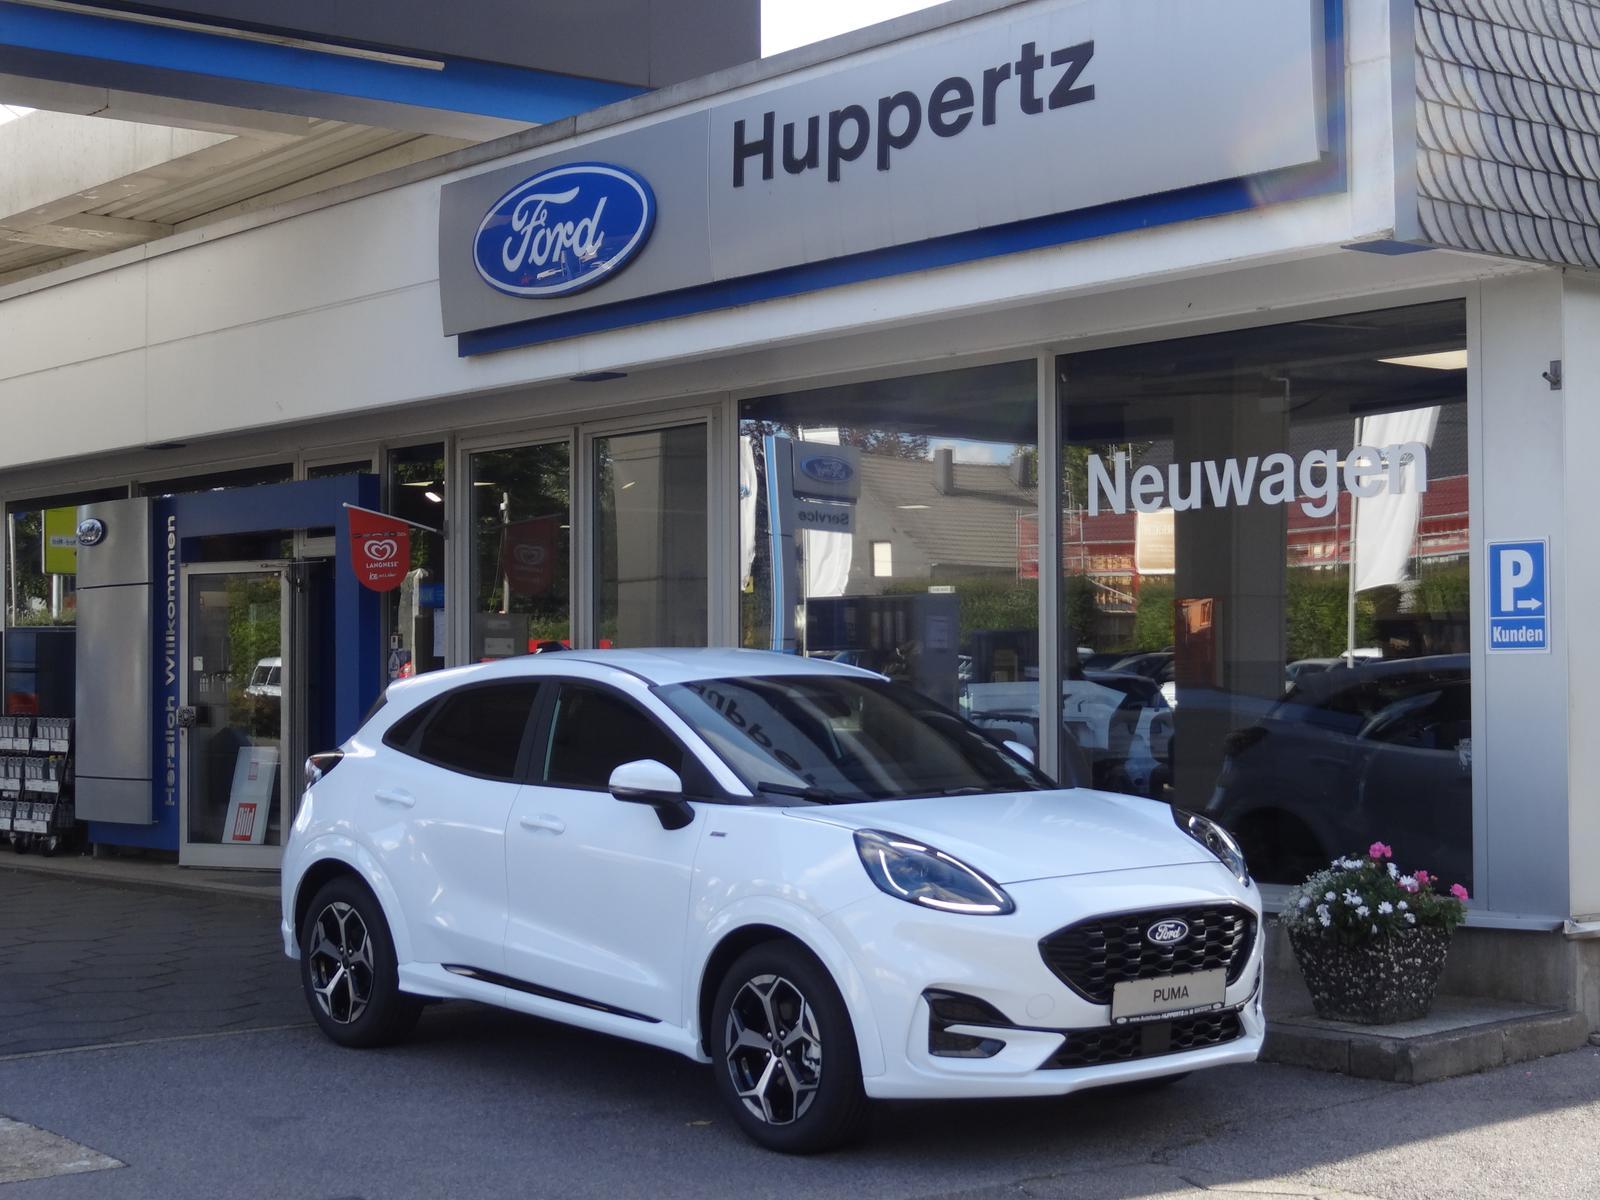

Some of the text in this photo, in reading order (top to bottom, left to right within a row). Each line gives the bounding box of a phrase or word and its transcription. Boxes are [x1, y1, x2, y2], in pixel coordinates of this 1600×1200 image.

[733, 40, 1096, 189] Huppertz
[502, 187, 606, 272] Ford
[1087, 440, 1428, 518] Neuwagen
[1499, 549, 1534, 612] P
[165, 515, 176, 806] Herzlich Willkommen
[1492, 625, 1543, 644] Kunden
[235, 807, 255, 836] Bild
[1155, 924, 1182, 941] Ford
[1153, 985, 1189, 1002] PUMA
